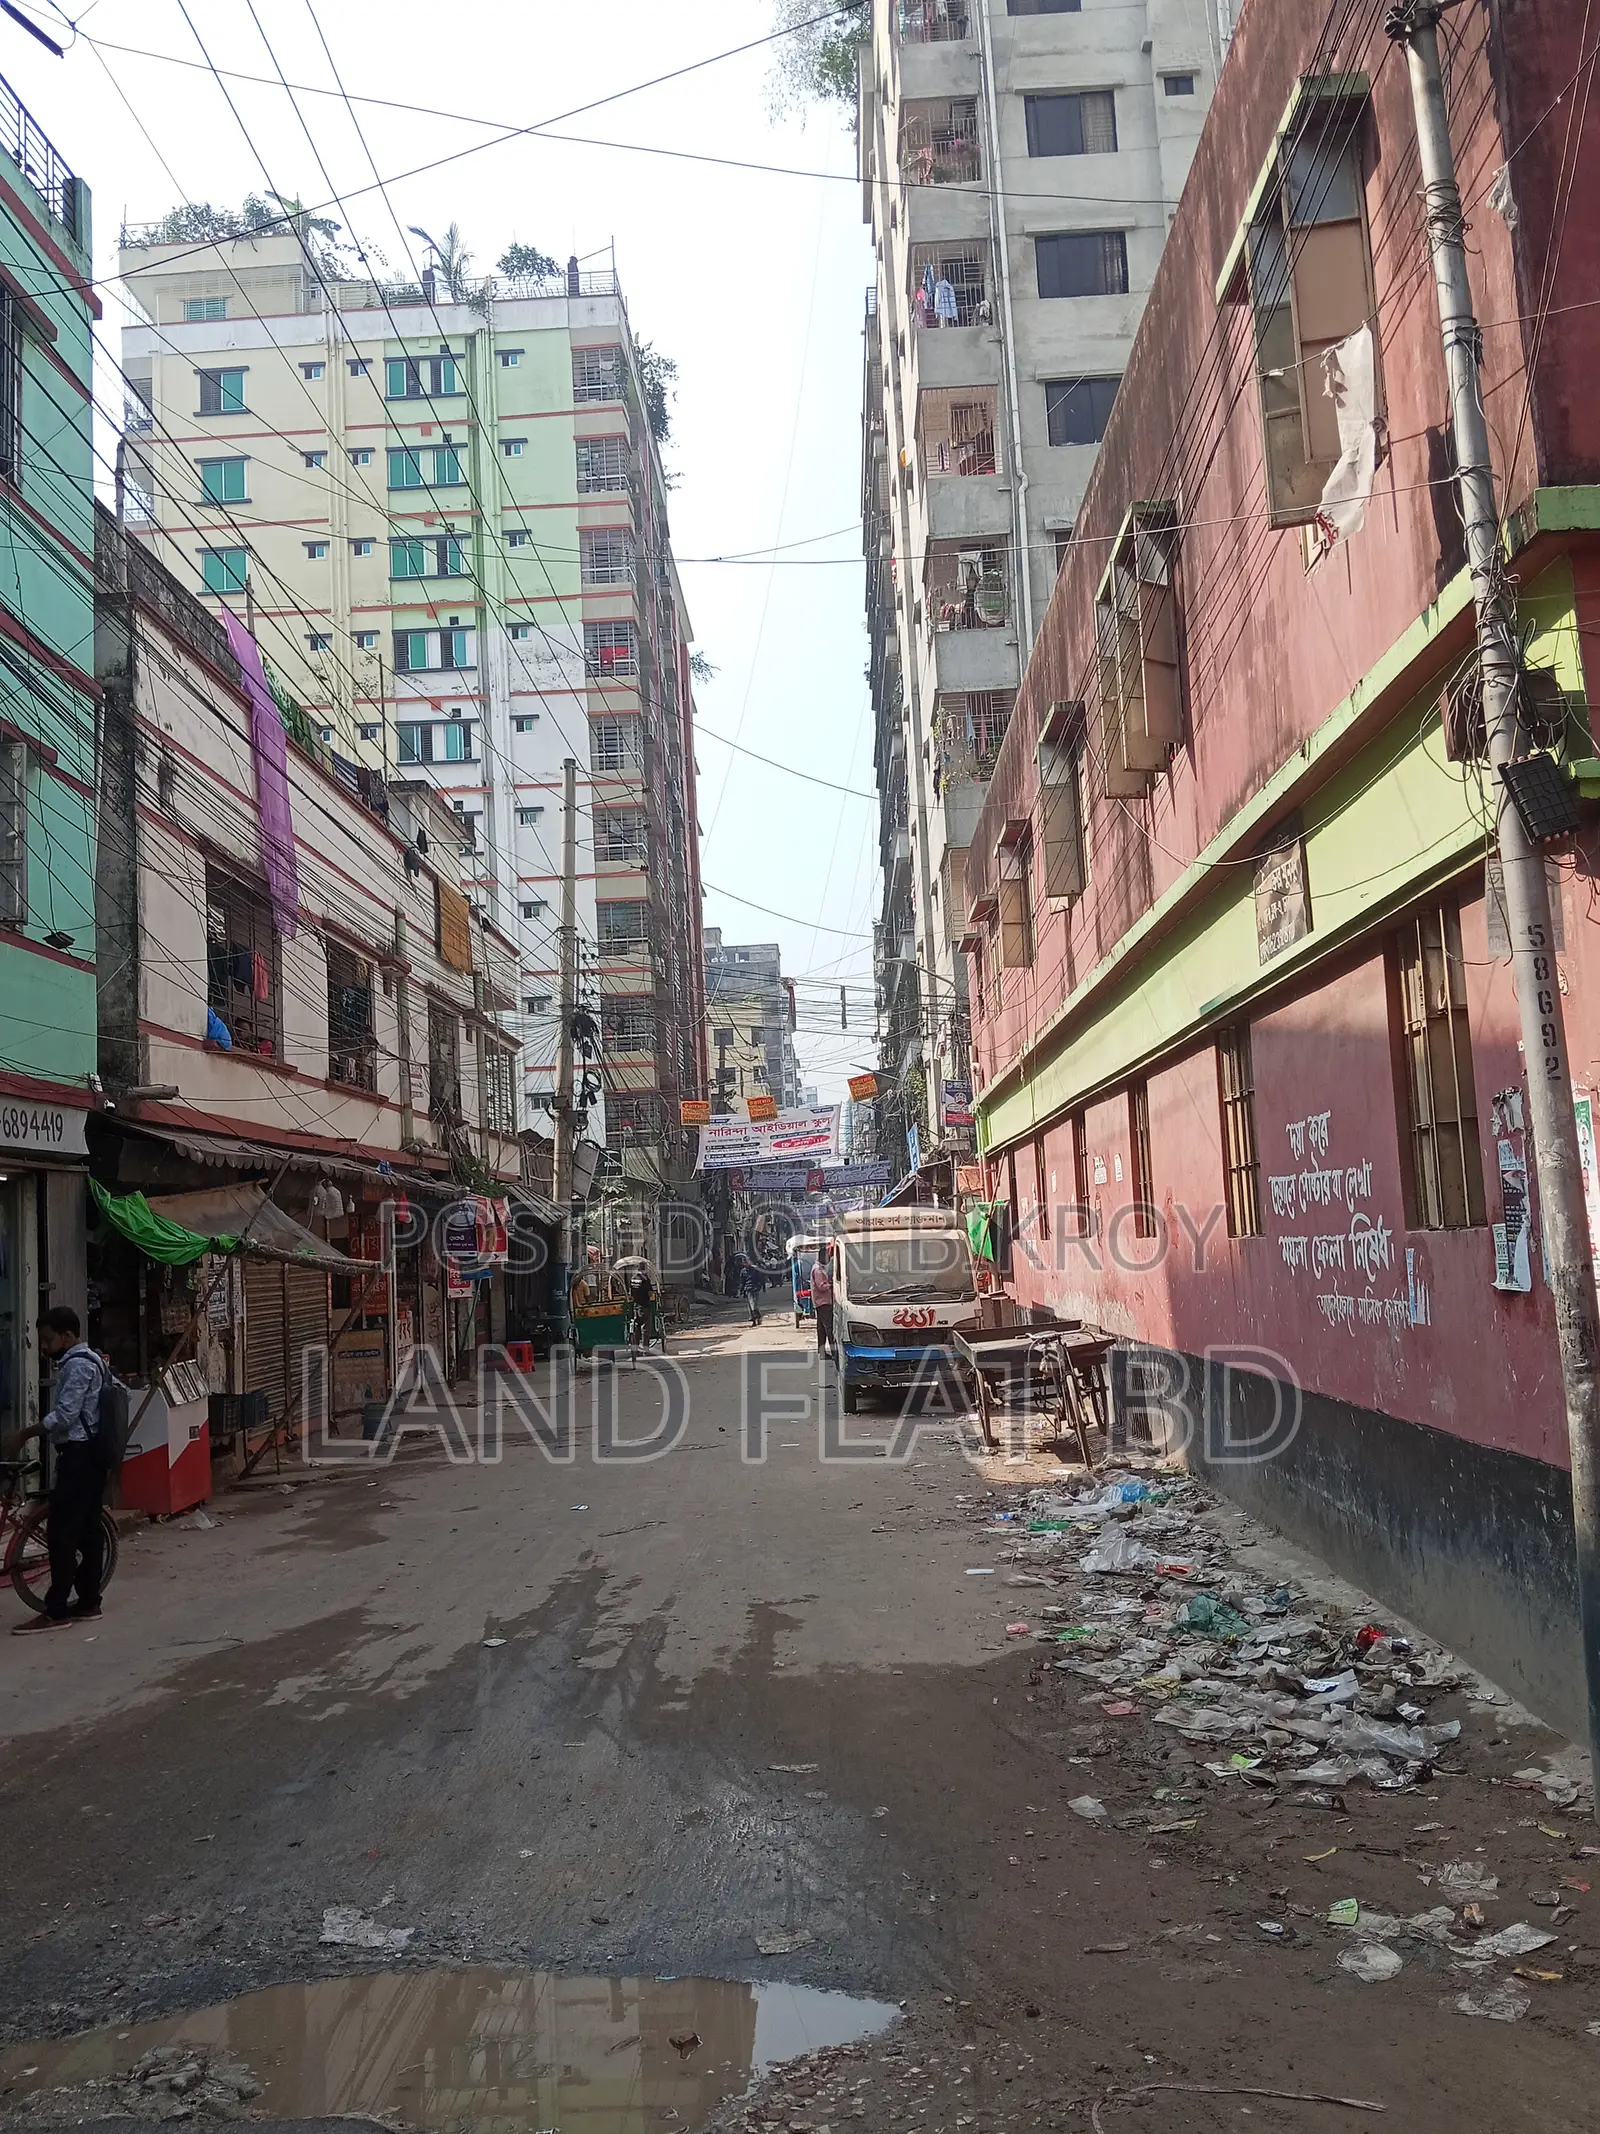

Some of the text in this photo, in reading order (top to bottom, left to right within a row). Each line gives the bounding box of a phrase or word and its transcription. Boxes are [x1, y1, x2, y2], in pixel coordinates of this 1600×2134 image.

[1527, 923, 1562, 1081] 58692
[0, 1106, 64, 1142] 6894419
[1285, 1110, 1331, 1161] দয়া করে
[1332, 1169, 1344, 1201] বা
[1345, 1158, 1373, 1213] লেখা
[1278, 1235, 1308, 1276] ময়লা
[1311, 1233, 1347, 1280] ফেলা
